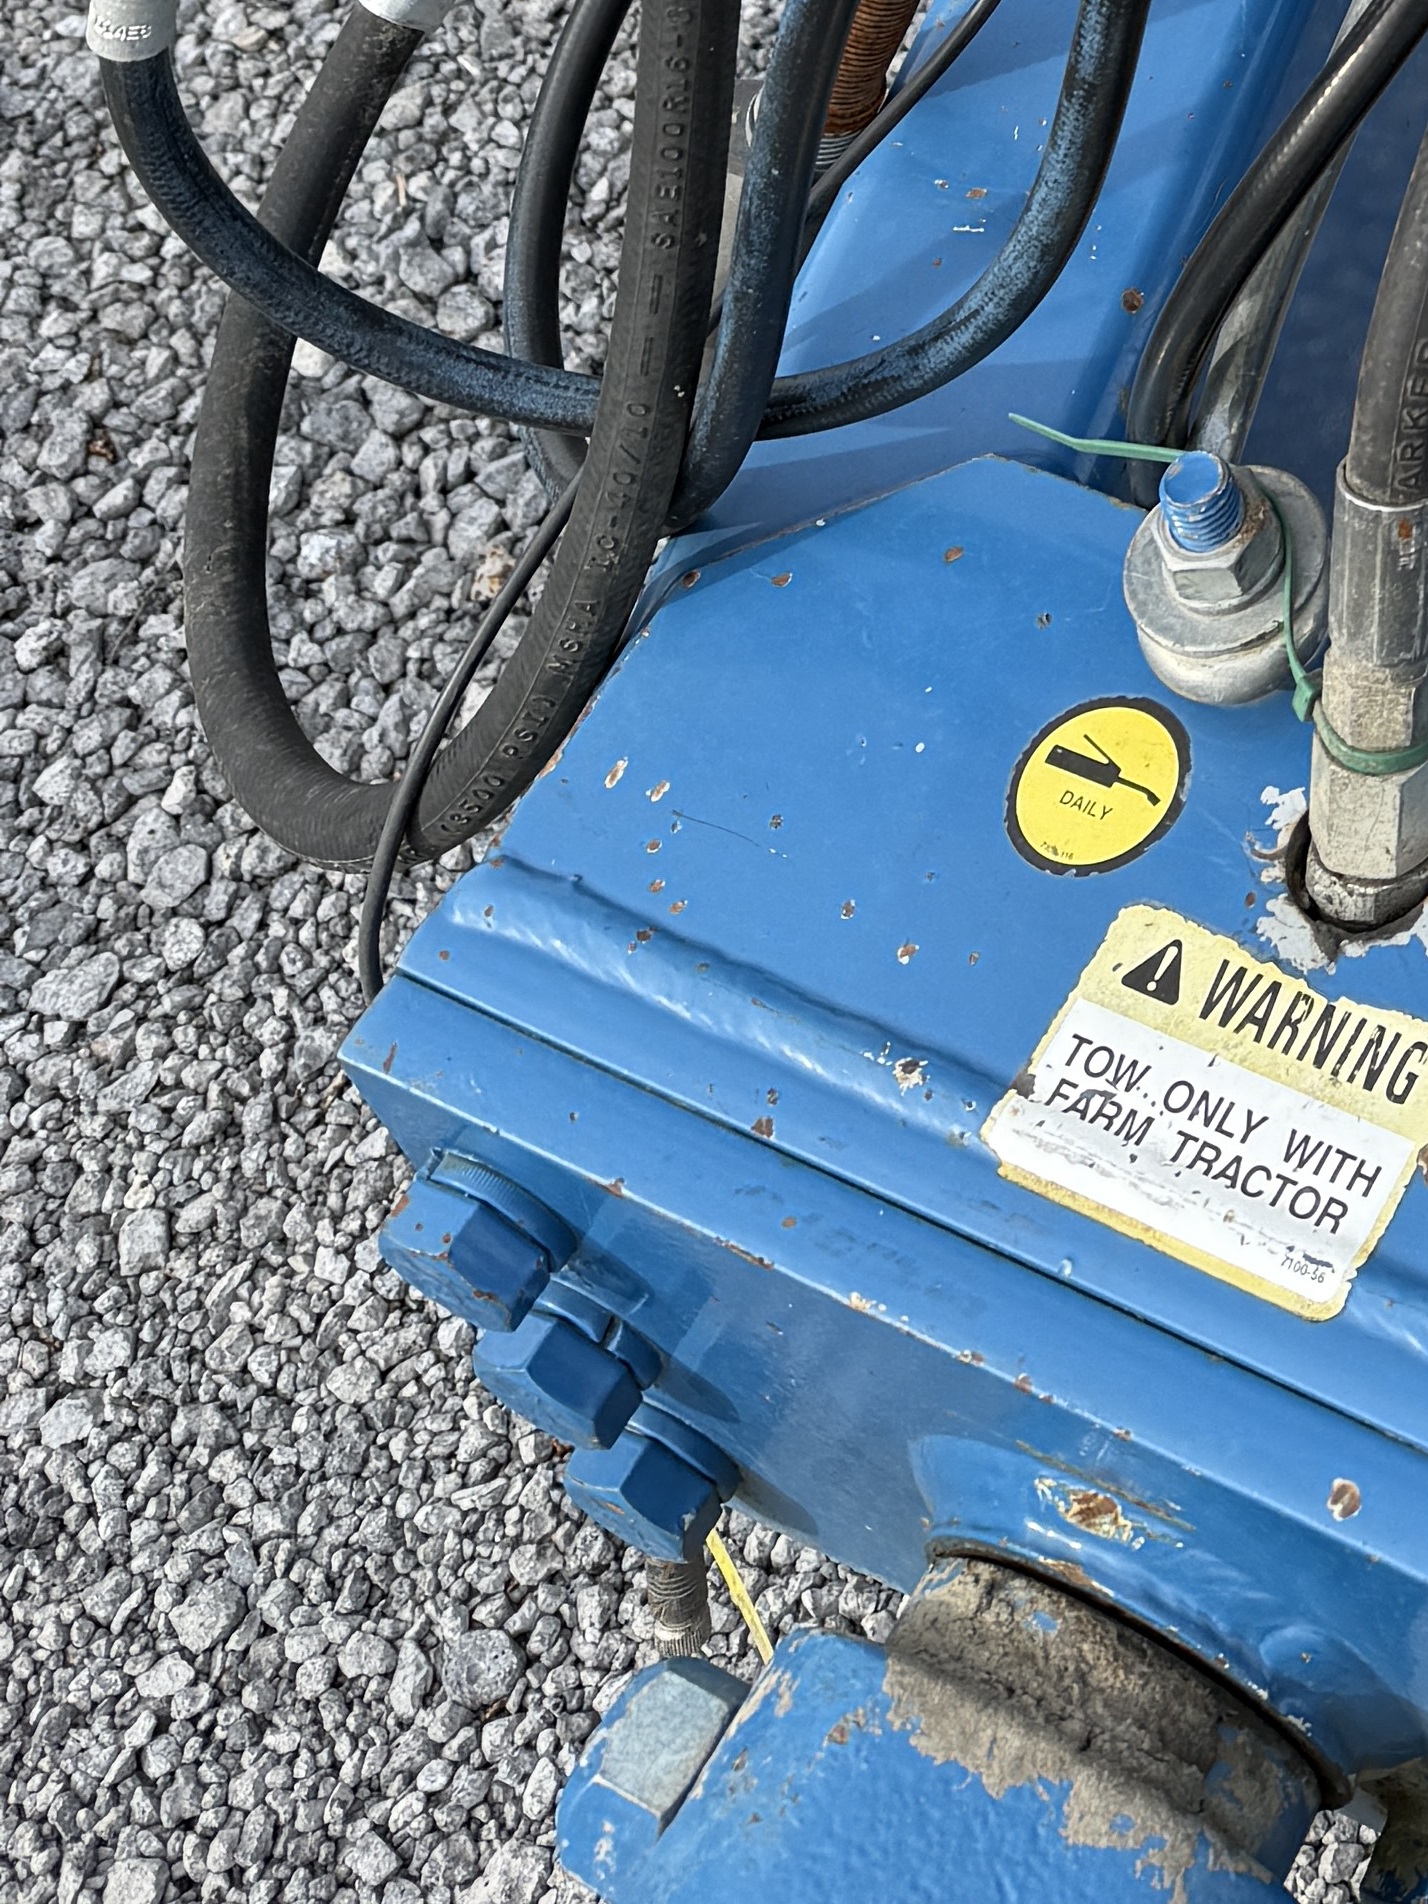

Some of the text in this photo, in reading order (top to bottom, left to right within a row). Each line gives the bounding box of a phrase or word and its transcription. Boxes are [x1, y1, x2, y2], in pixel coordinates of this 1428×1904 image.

[1059, 790, 1113, 820] DAILY
[1199, 959, 1428, 1105] WARNING
[1044, 1078, 1349, 1235] FARM TRACTOR
[1163, 1080, 1269, 1144] ONLY
[1283, 1129, 1382, 1198] WITH
